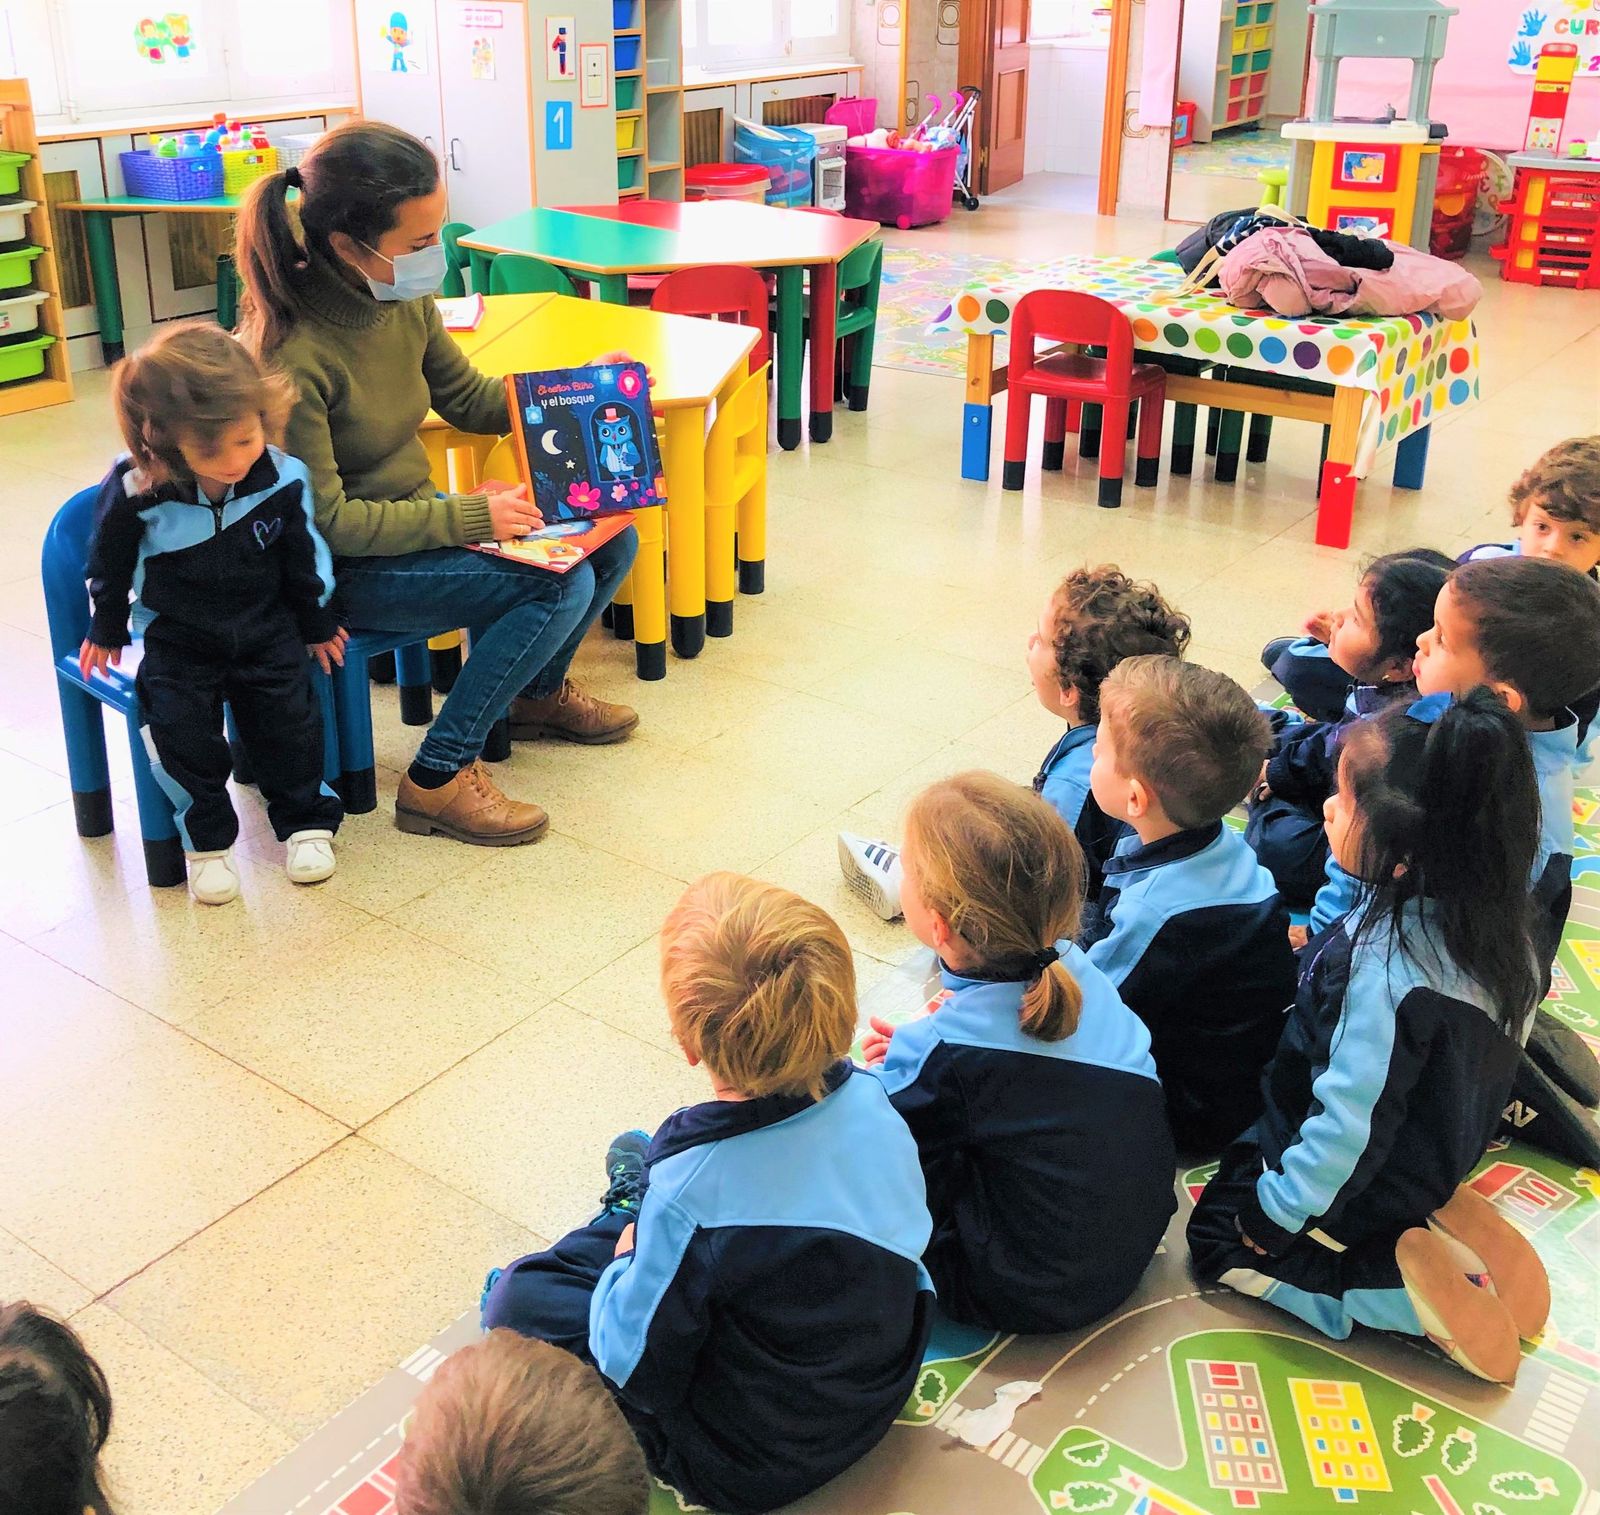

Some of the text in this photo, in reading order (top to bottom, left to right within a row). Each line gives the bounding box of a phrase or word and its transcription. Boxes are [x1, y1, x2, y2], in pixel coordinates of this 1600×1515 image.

[1554, 18, 1600, 35] CUR
[553, 107, 564, 144] 1
[541, 394, 595, 410] y el bosque
